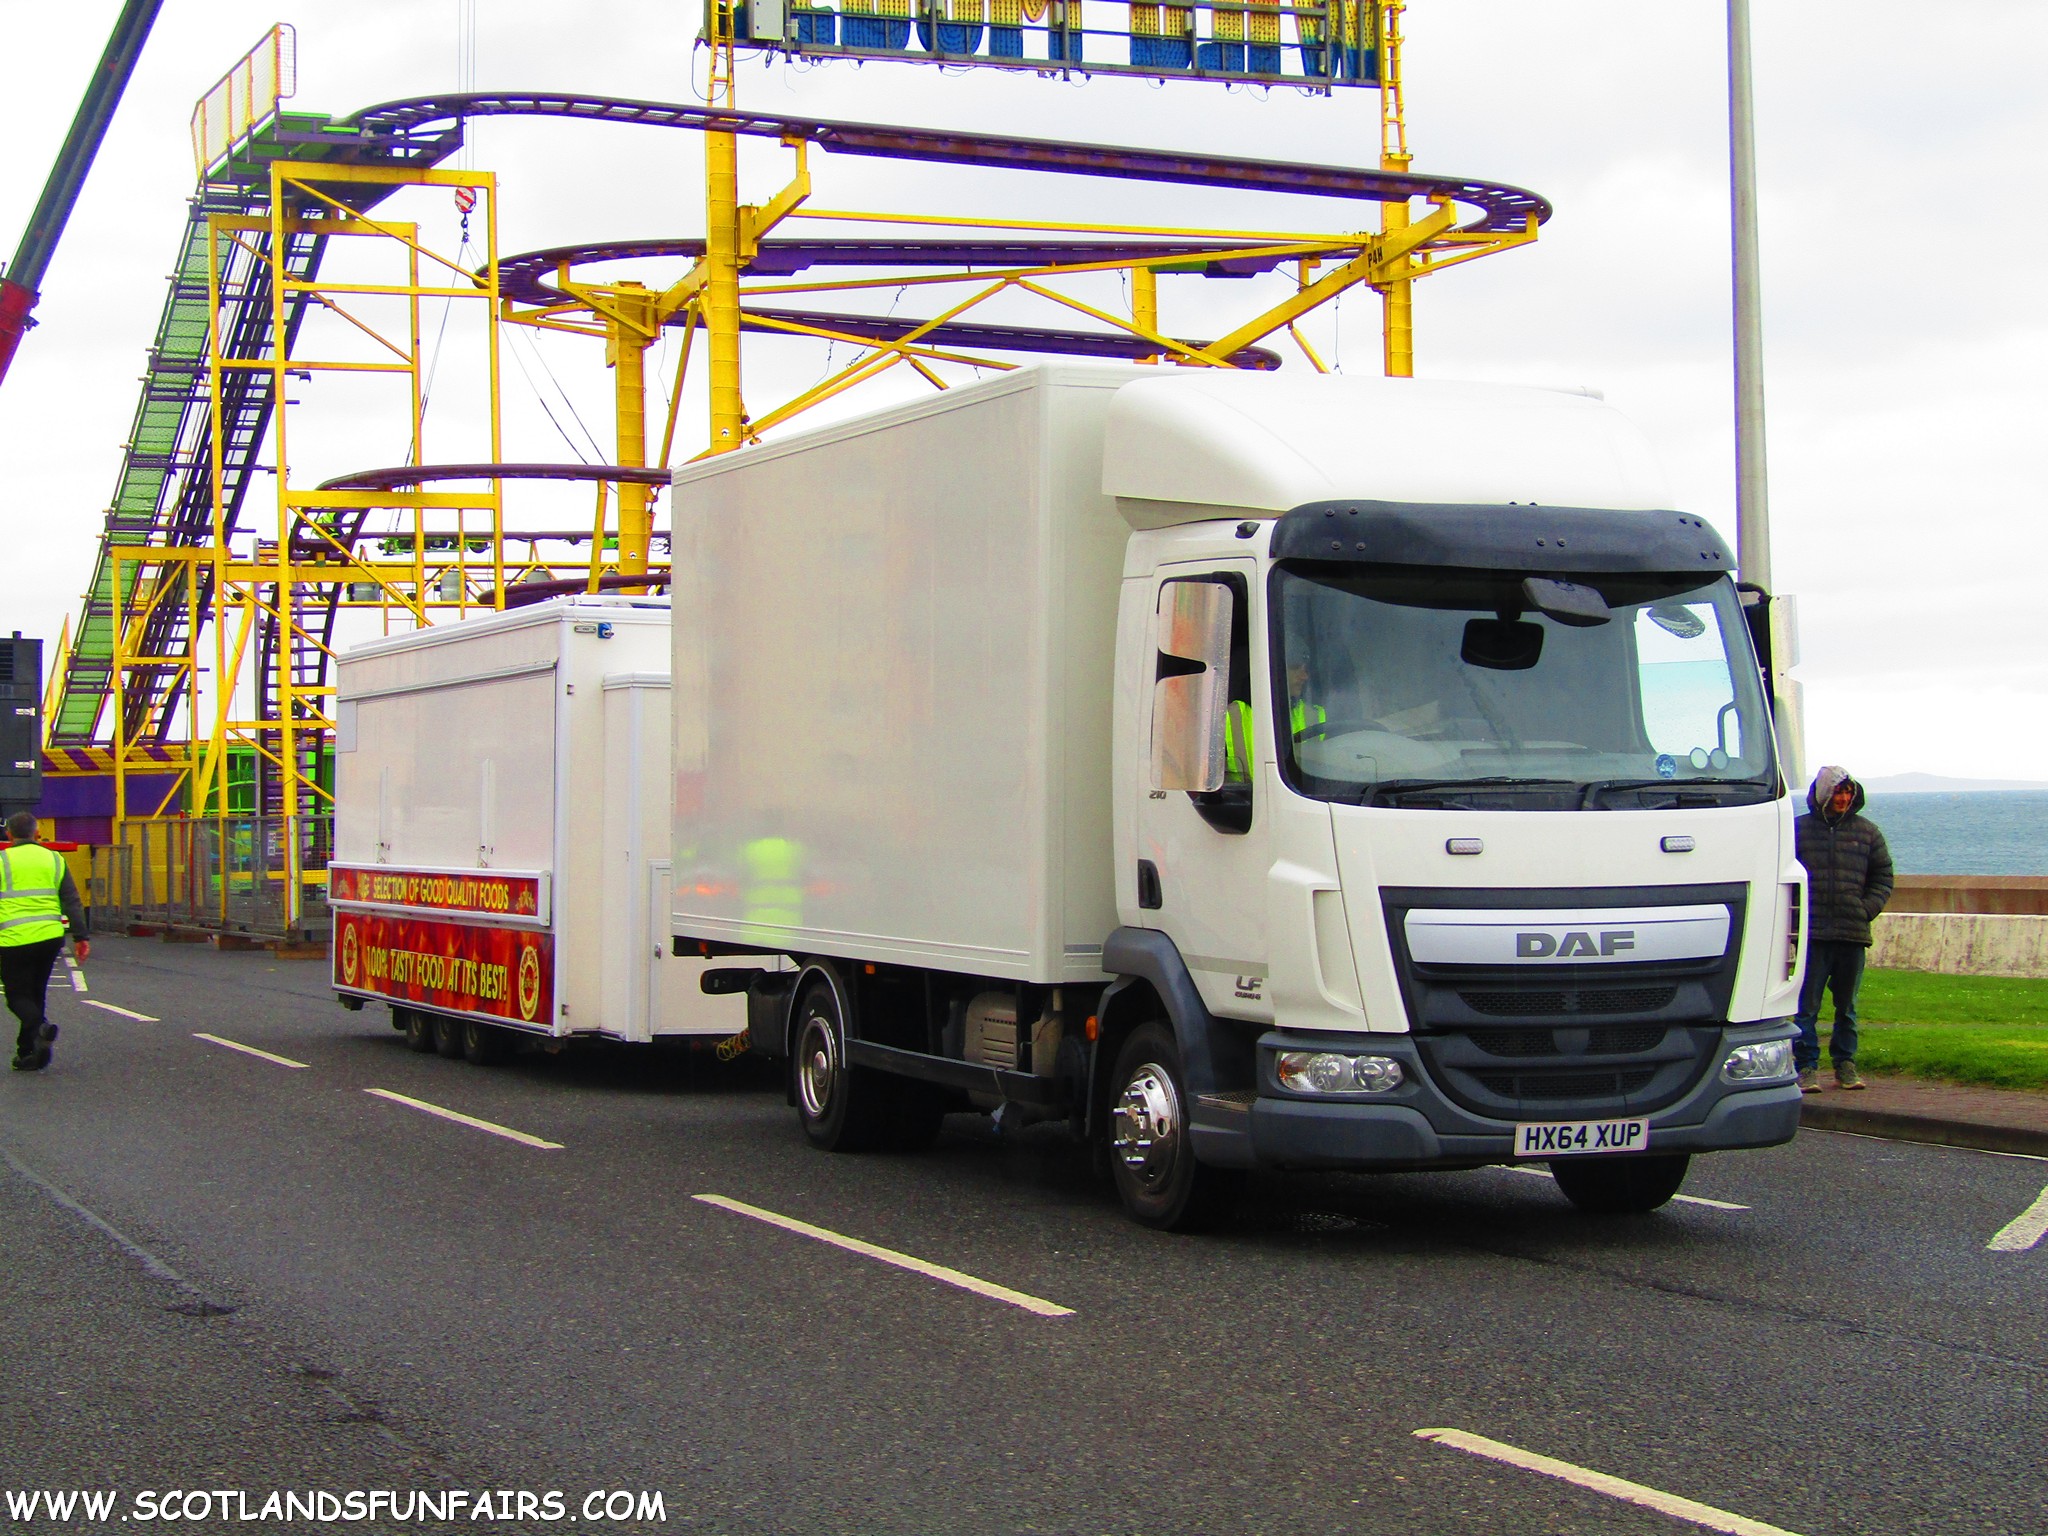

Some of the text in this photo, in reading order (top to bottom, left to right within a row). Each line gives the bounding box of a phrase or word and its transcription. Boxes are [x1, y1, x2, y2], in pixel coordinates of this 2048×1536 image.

[373, 875, 407, 900] SELECTION
[408, 878, 419, 902] OF
[420, 878, 445, 904] GOOD
[447, 879, 479, 907] QUALITY
[480, 882, 509, 910] FOODS
[1516, 930, 1635, 958] DAF
[390, 949, 415, 983] TASTY
[416, 953, 444, 990] FOOD
[447, 958, 460, 992] AT
[480, 962, 508, 1001] BEST!
[1236, 975, 1263, 991] LF
[1525, 1122, 1641, 1151] HX64 XUP
